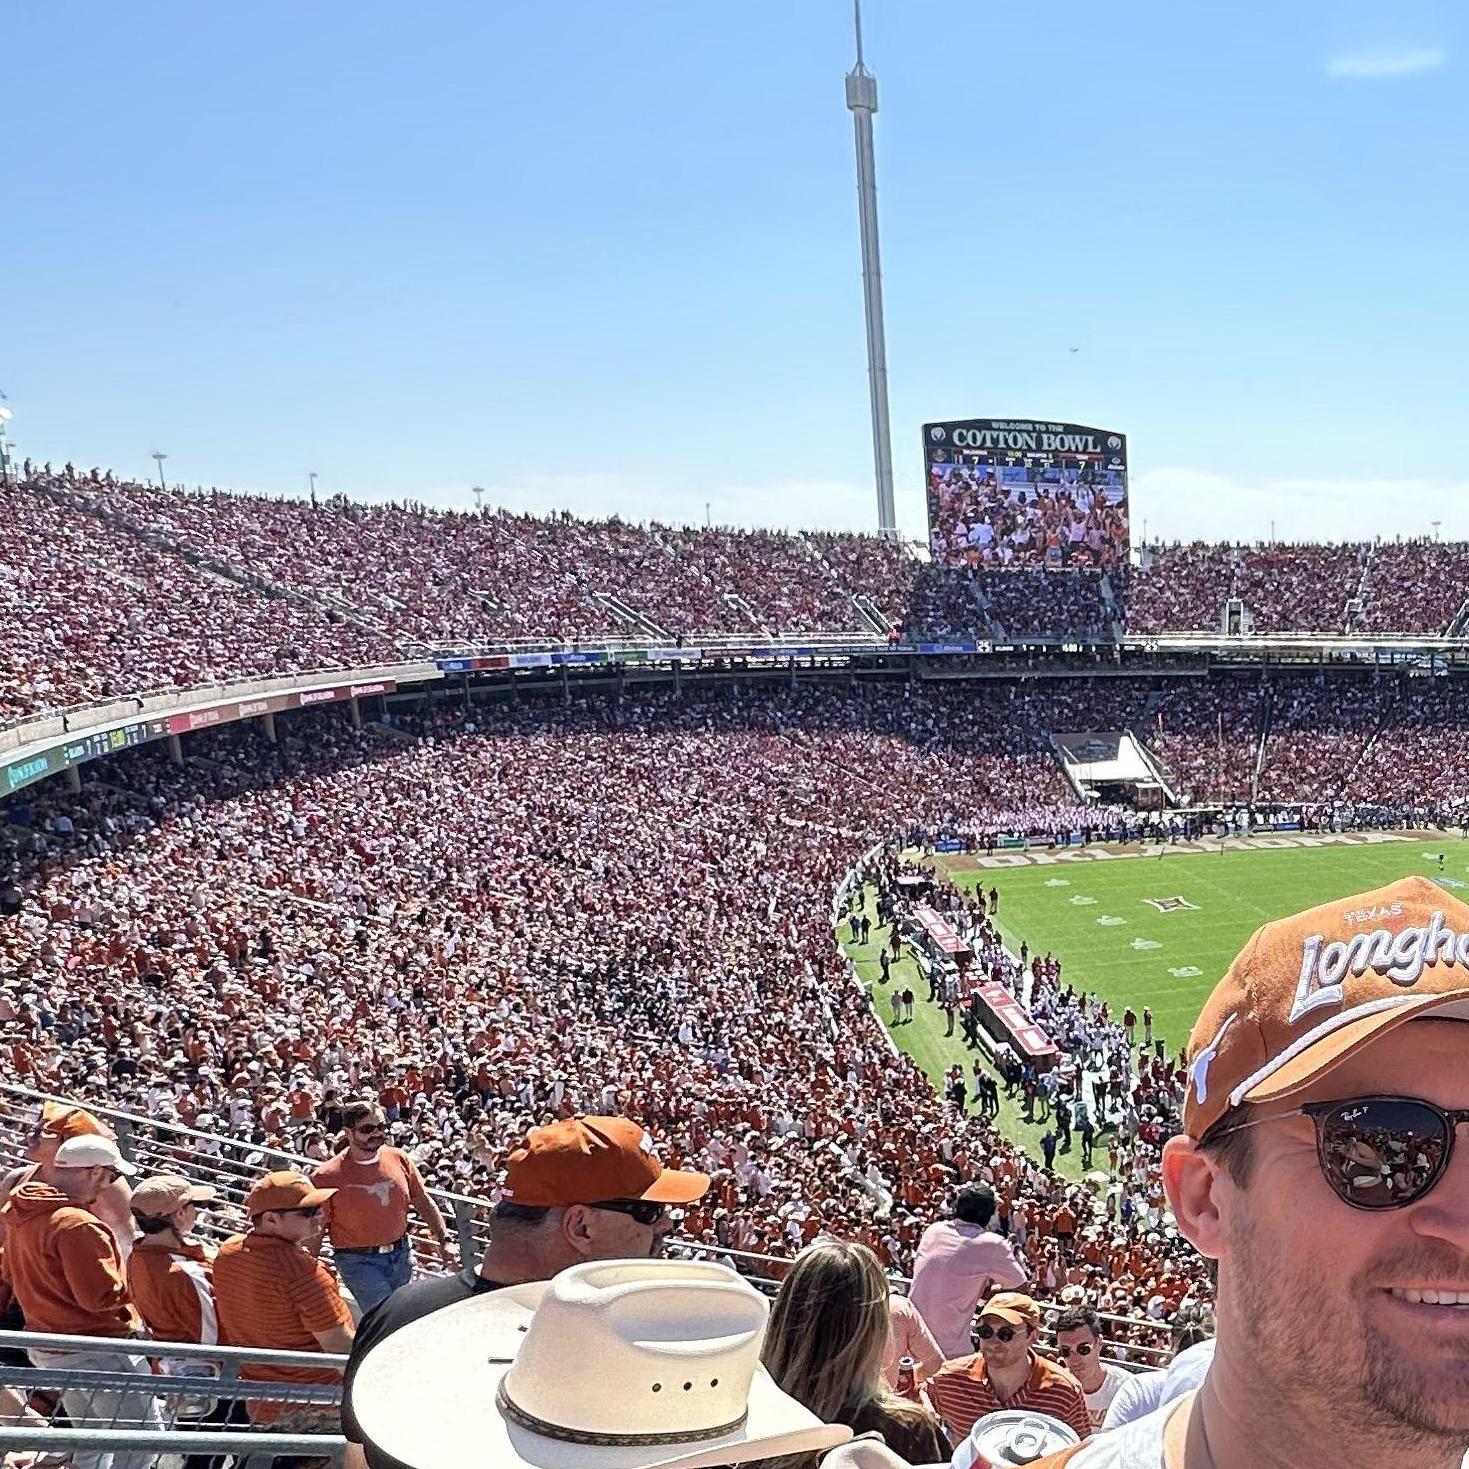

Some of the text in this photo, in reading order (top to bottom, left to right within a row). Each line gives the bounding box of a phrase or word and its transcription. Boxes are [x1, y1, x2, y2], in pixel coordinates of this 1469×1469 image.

[991, 421, 1064, 432] WELCOME TO THE
[952, 429, 1101, 453] COTTON BOWL
[1343, 901, 1403, 927] TEXAS
